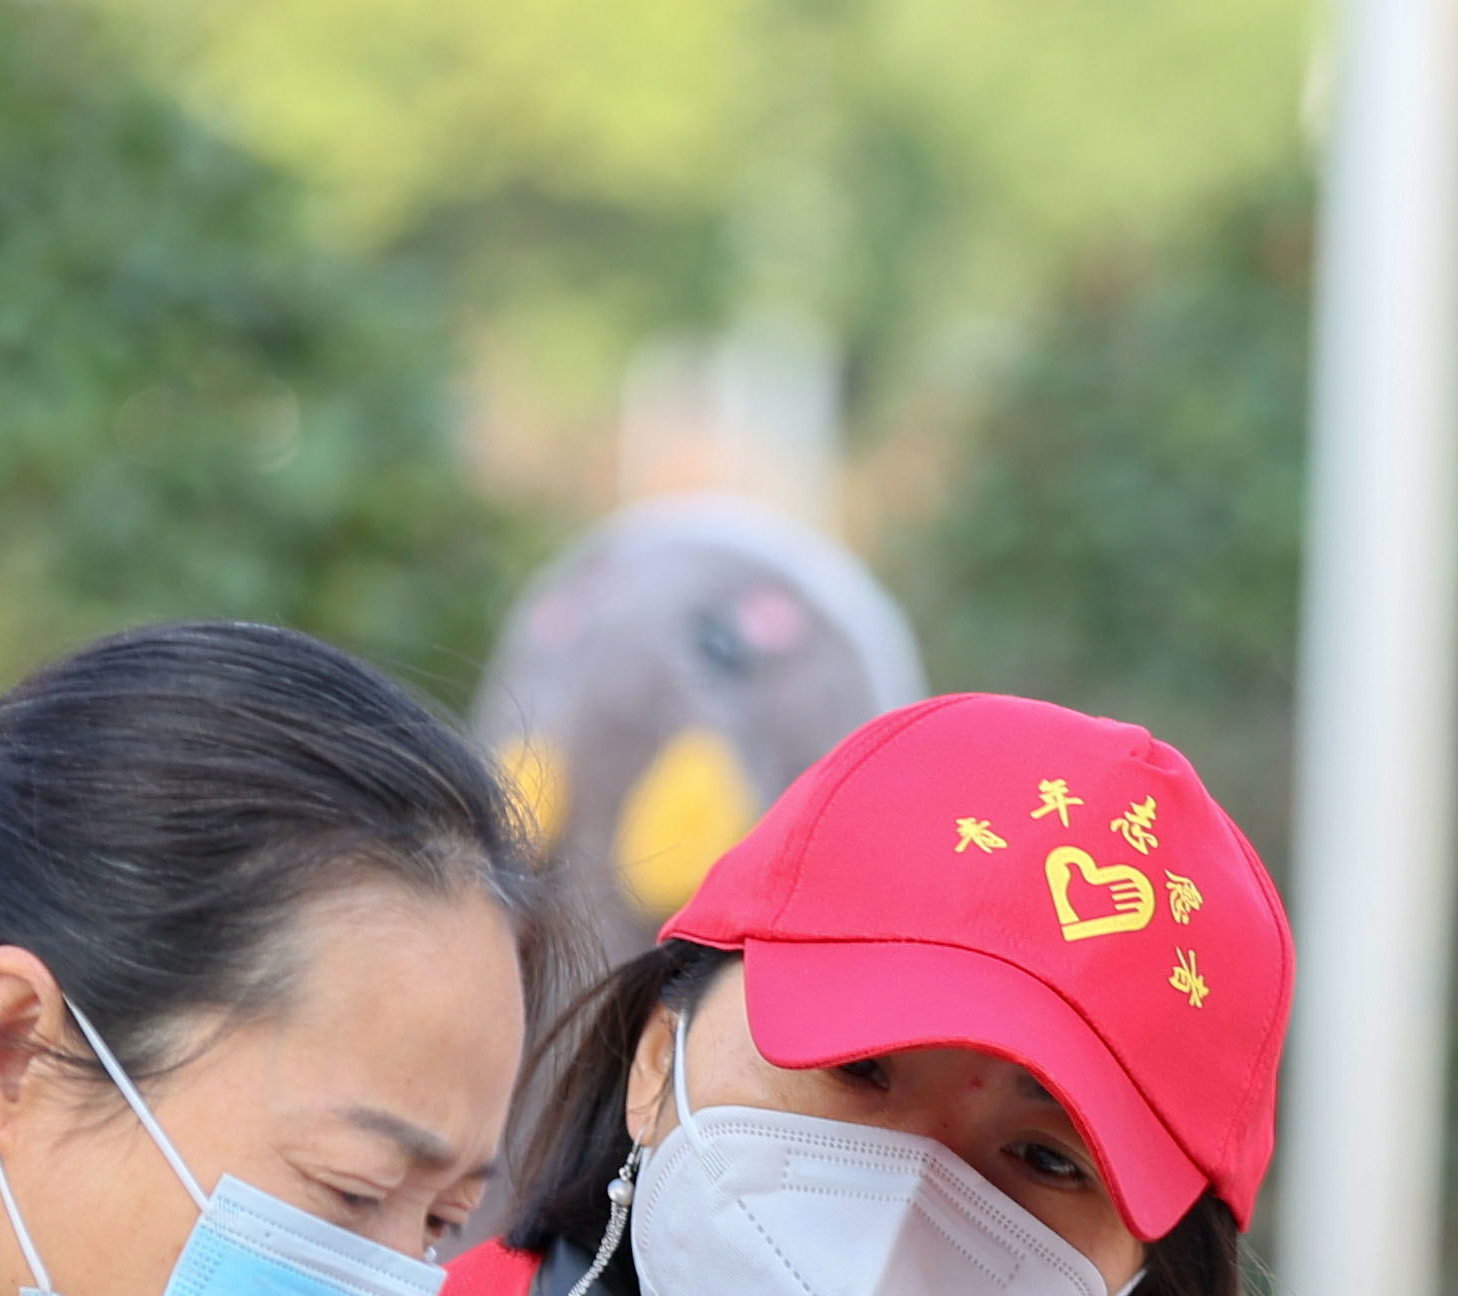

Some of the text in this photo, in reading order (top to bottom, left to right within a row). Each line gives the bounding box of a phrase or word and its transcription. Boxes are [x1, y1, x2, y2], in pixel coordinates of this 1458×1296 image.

[954, 778, 1211, 1010] 青年志愿者
